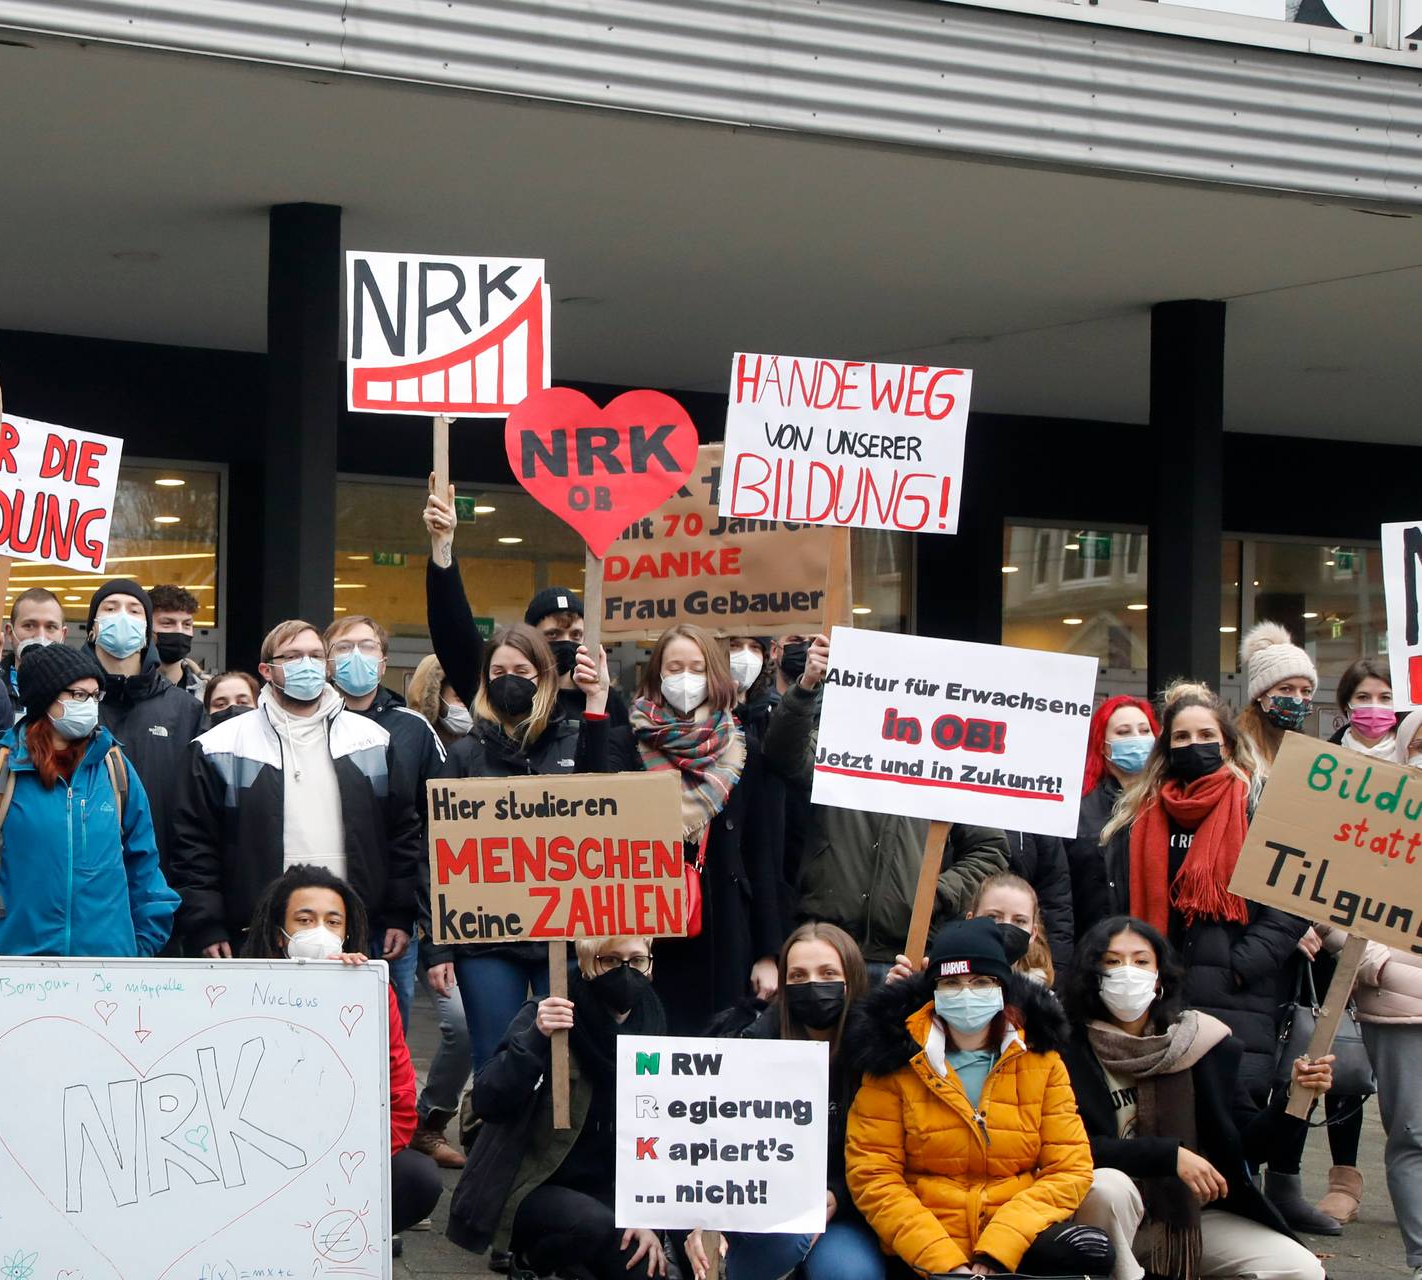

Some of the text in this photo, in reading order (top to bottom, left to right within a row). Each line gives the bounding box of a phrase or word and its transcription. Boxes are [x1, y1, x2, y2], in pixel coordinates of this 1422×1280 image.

[352, 259, 523, 359] NRK
[39, 433, 108, 487] DIE
[520, 424, 682, 479] NRK
[764, 422, 922, 461] VON UNSERER
[567, 485, 613, 511] OB
[731, 453, 951, 530] BILDUNG!
[616, 517, 654, 540] it
[663, 513, 703, 537] 70
[603, 547, 742, 582] DANKE
[605, 590, 824, 620] Frau Gebauer
[825, 667, 1091, 717] Abitur für Erwachsene
[882, 707, 1007, 754] in OB!
[815, 747, 1062, 794] Jetzt und in Zukunft!
[1307, 753, 1422, 822] Bildu
[432, 788, 617, 822] Hier studieren
[435, 836, 683, 885] MENSCHEN
[1333, 818, 1422, 864] statt
[439, 883, 683, 940] keine ZAHLEN
[940, 960, 970, 976] MARVEL
[252, 982, 319, 1008] Nucleus
[63, 1036, 307, 1214] NRK
[667, 1096, 813, 1125] egierung
[676, 1180, 768, 1205] nicht!
